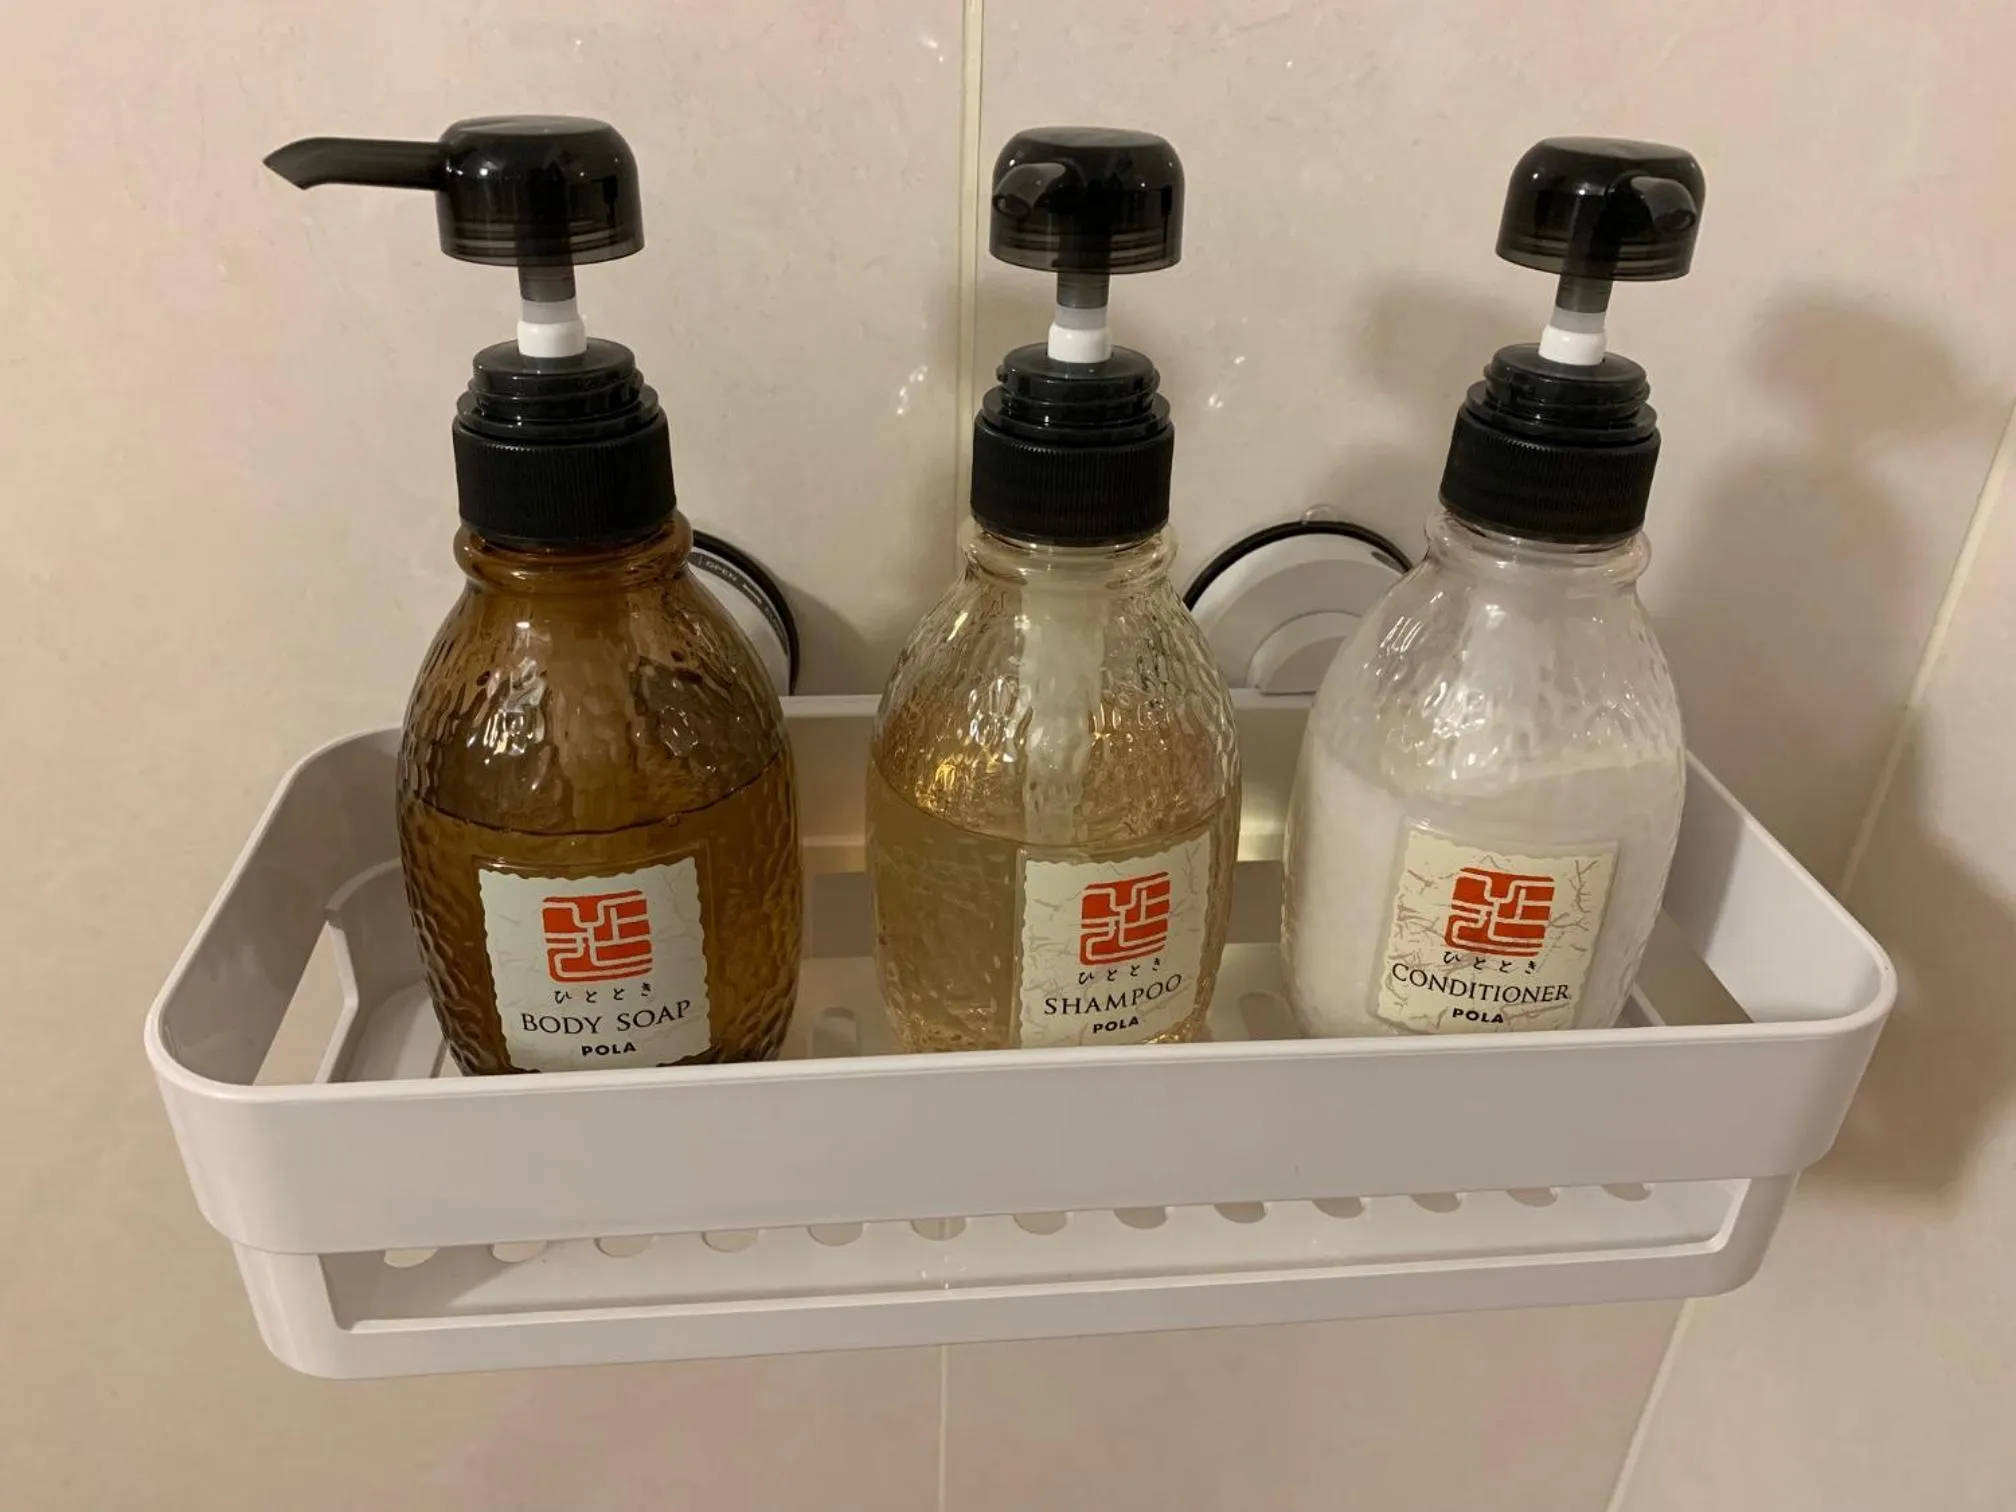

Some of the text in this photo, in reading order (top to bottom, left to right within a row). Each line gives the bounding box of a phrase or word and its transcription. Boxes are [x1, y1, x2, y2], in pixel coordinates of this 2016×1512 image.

[1078, 957, 1161, 985] ひととき
[1443, 951, 1537, 974] ひととき
[554, 982, 652, 1004] ひととき
[1044, 974, 1182, 1015] SHAMPOO
[1392, 963, 1570, 1004] CONDITIONER
[521, 1000, 690, 1034] BODY SOAP
[1093, 1016, 1140, 1034] POLA
[1452, 1007, 1504, 1024] POLA
[581, 1042, 636, 1057] POLA
